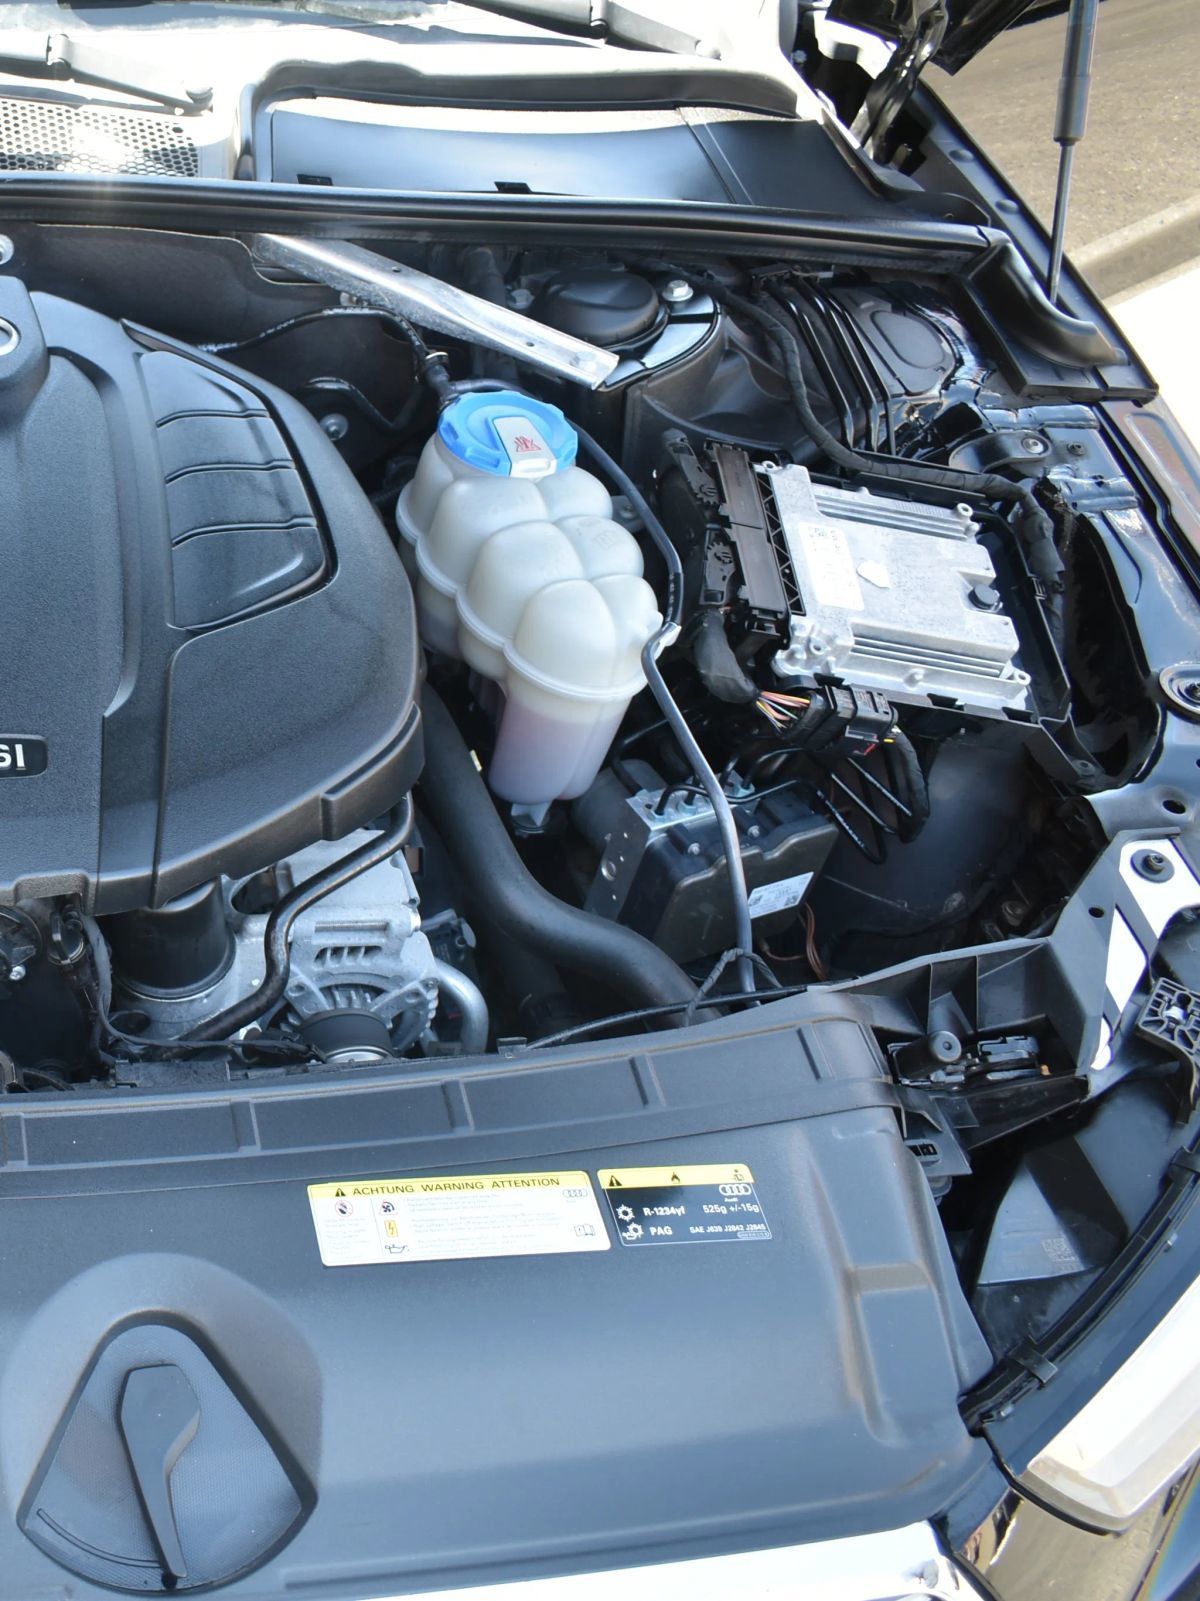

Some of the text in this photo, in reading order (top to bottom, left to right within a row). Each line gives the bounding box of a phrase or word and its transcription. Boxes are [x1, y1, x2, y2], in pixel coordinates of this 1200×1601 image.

[352, 1178, 561, 1196] ACHTUNG WARNING ATTENTION
[643, 1205, 686, 1217] R-1234yf
[702, 1203, 760, 1215] 525g +/-15g
[650, 1226, 673, 1236] PAG
[689, 1225, 705, 1234] SAE
